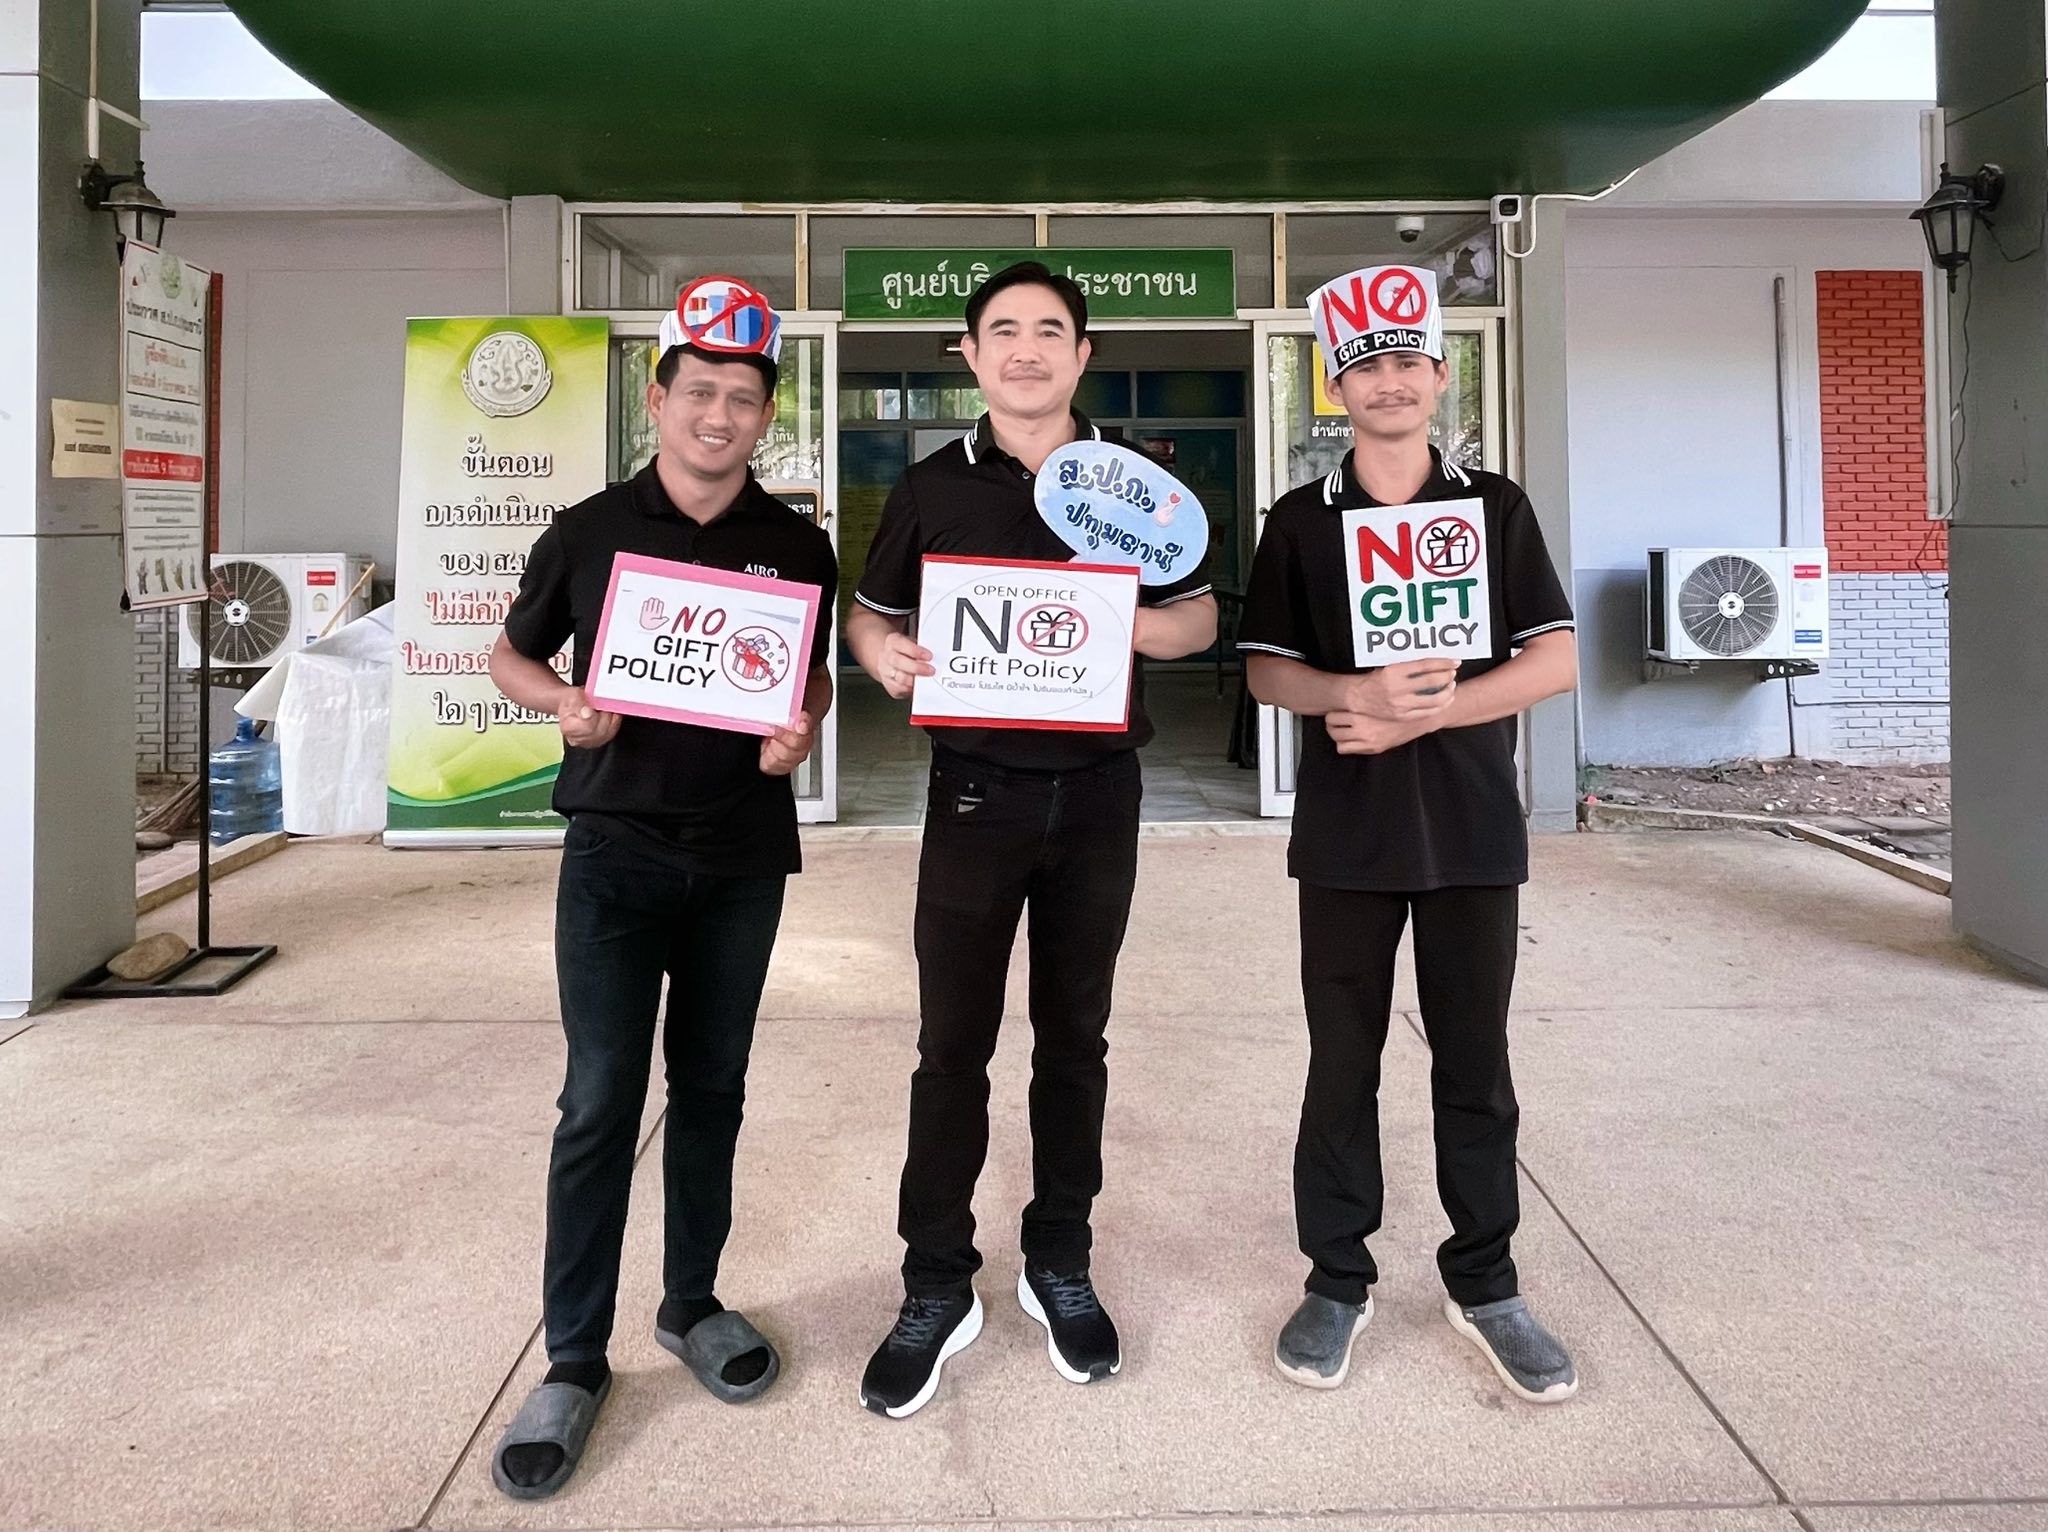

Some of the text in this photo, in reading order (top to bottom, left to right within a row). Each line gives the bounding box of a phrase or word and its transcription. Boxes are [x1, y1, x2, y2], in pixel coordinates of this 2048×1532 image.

[1338, 330, 1425, 363] Gift Policy
[461, 435, 550, 474] ขั้นตอน
[1059, 457, 1156, 514] ส.ป.ก.
[1065, 502, 1184, 573] ปทุมธานี
[440, 552, 484, 571] ของ
[973, 584, 1078, 601] OPEN OFFICE
[1360, 577, 1479, 627] GIFT
[671, 604, 727, 636] NO
[653, 634, 720, 662] GIFT
[1366, 622, 1479, 653] POLICY
[607, 654, 716, 688] POLICY
[949, 655, 1087, 684] Gift Policy
[433, 691, 460, 720] ใด
